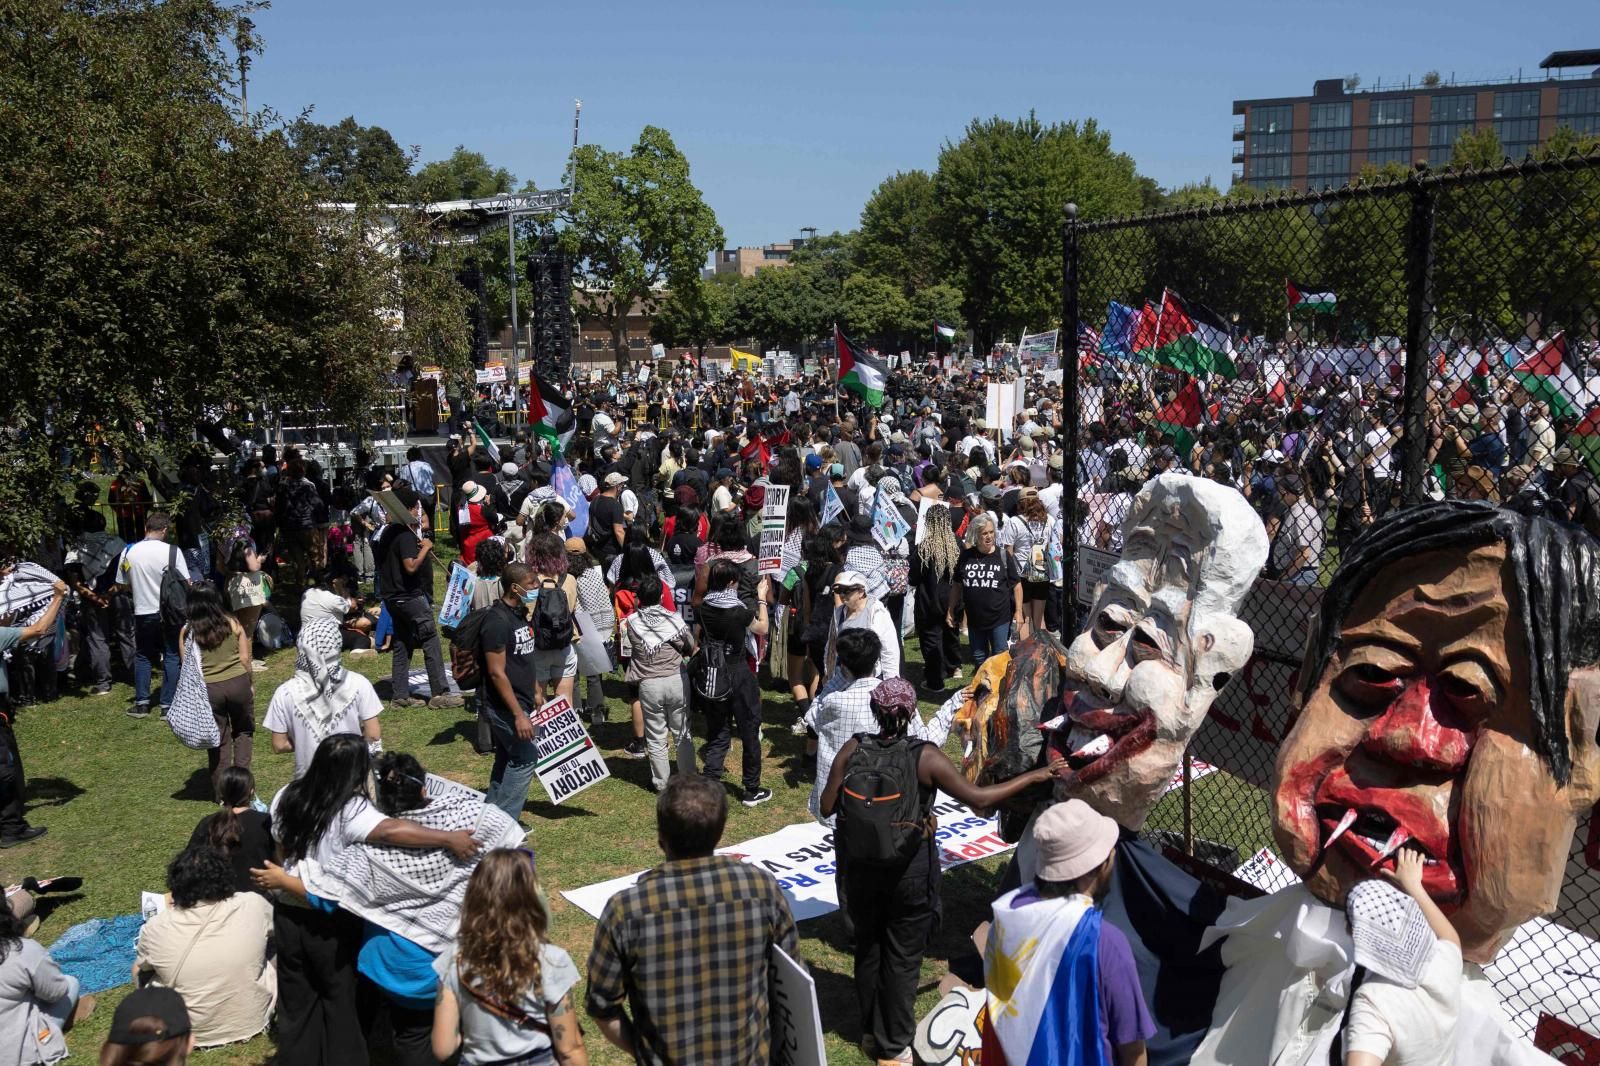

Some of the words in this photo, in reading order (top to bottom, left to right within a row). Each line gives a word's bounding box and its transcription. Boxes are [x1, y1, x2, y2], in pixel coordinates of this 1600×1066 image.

[965, 563, 986, 571] NOT
[989, 564, 1001, 572] IN
[967, 570, 995, 579] OUR
[962, 578, 999, 588] NAME
[542, 701, 567, 719] FRSO
[571, 758, 581, 769] TO
[558, 764, 572, 775] THE
[550, 759, 605, 800] VICTORY
